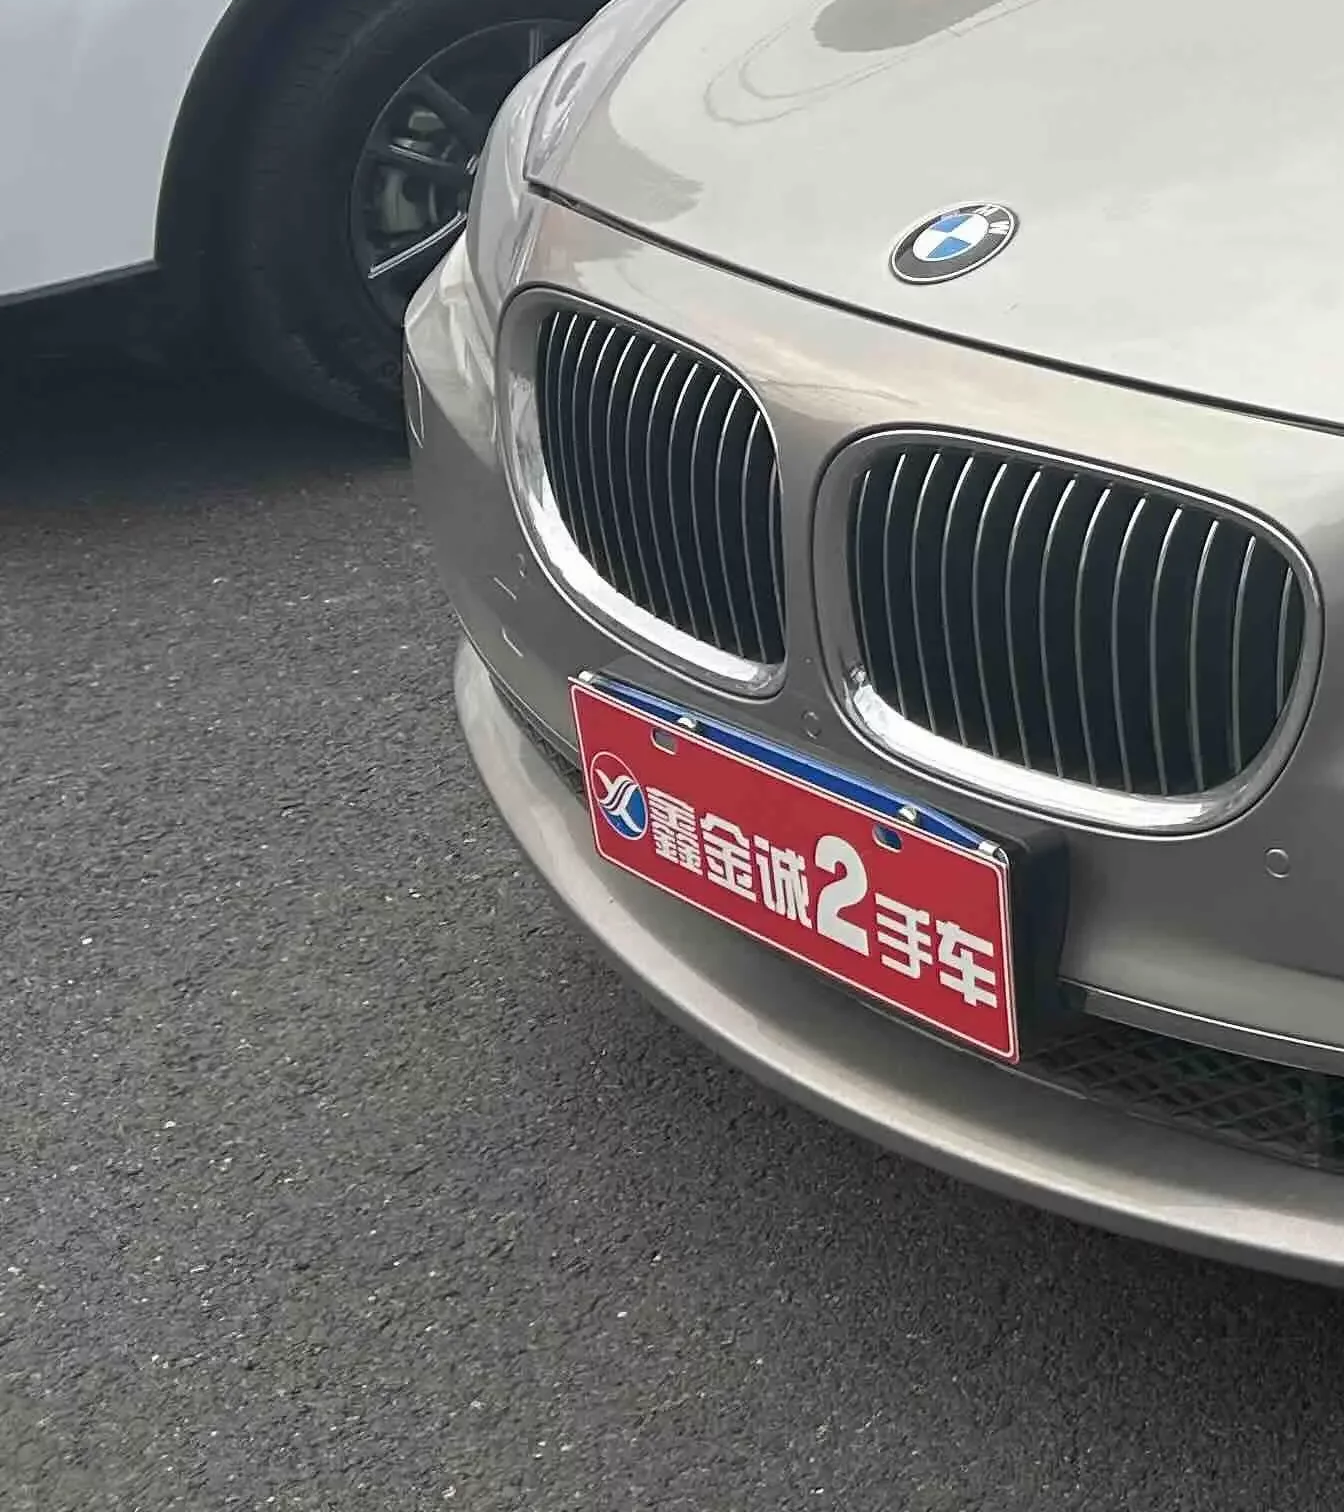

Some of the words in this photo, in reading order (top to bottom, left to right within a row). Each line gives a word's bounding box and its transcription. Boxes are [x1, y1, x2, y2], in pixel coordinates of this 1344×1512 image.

[645, 785, 999, 1008] 鑫金诚2手车
